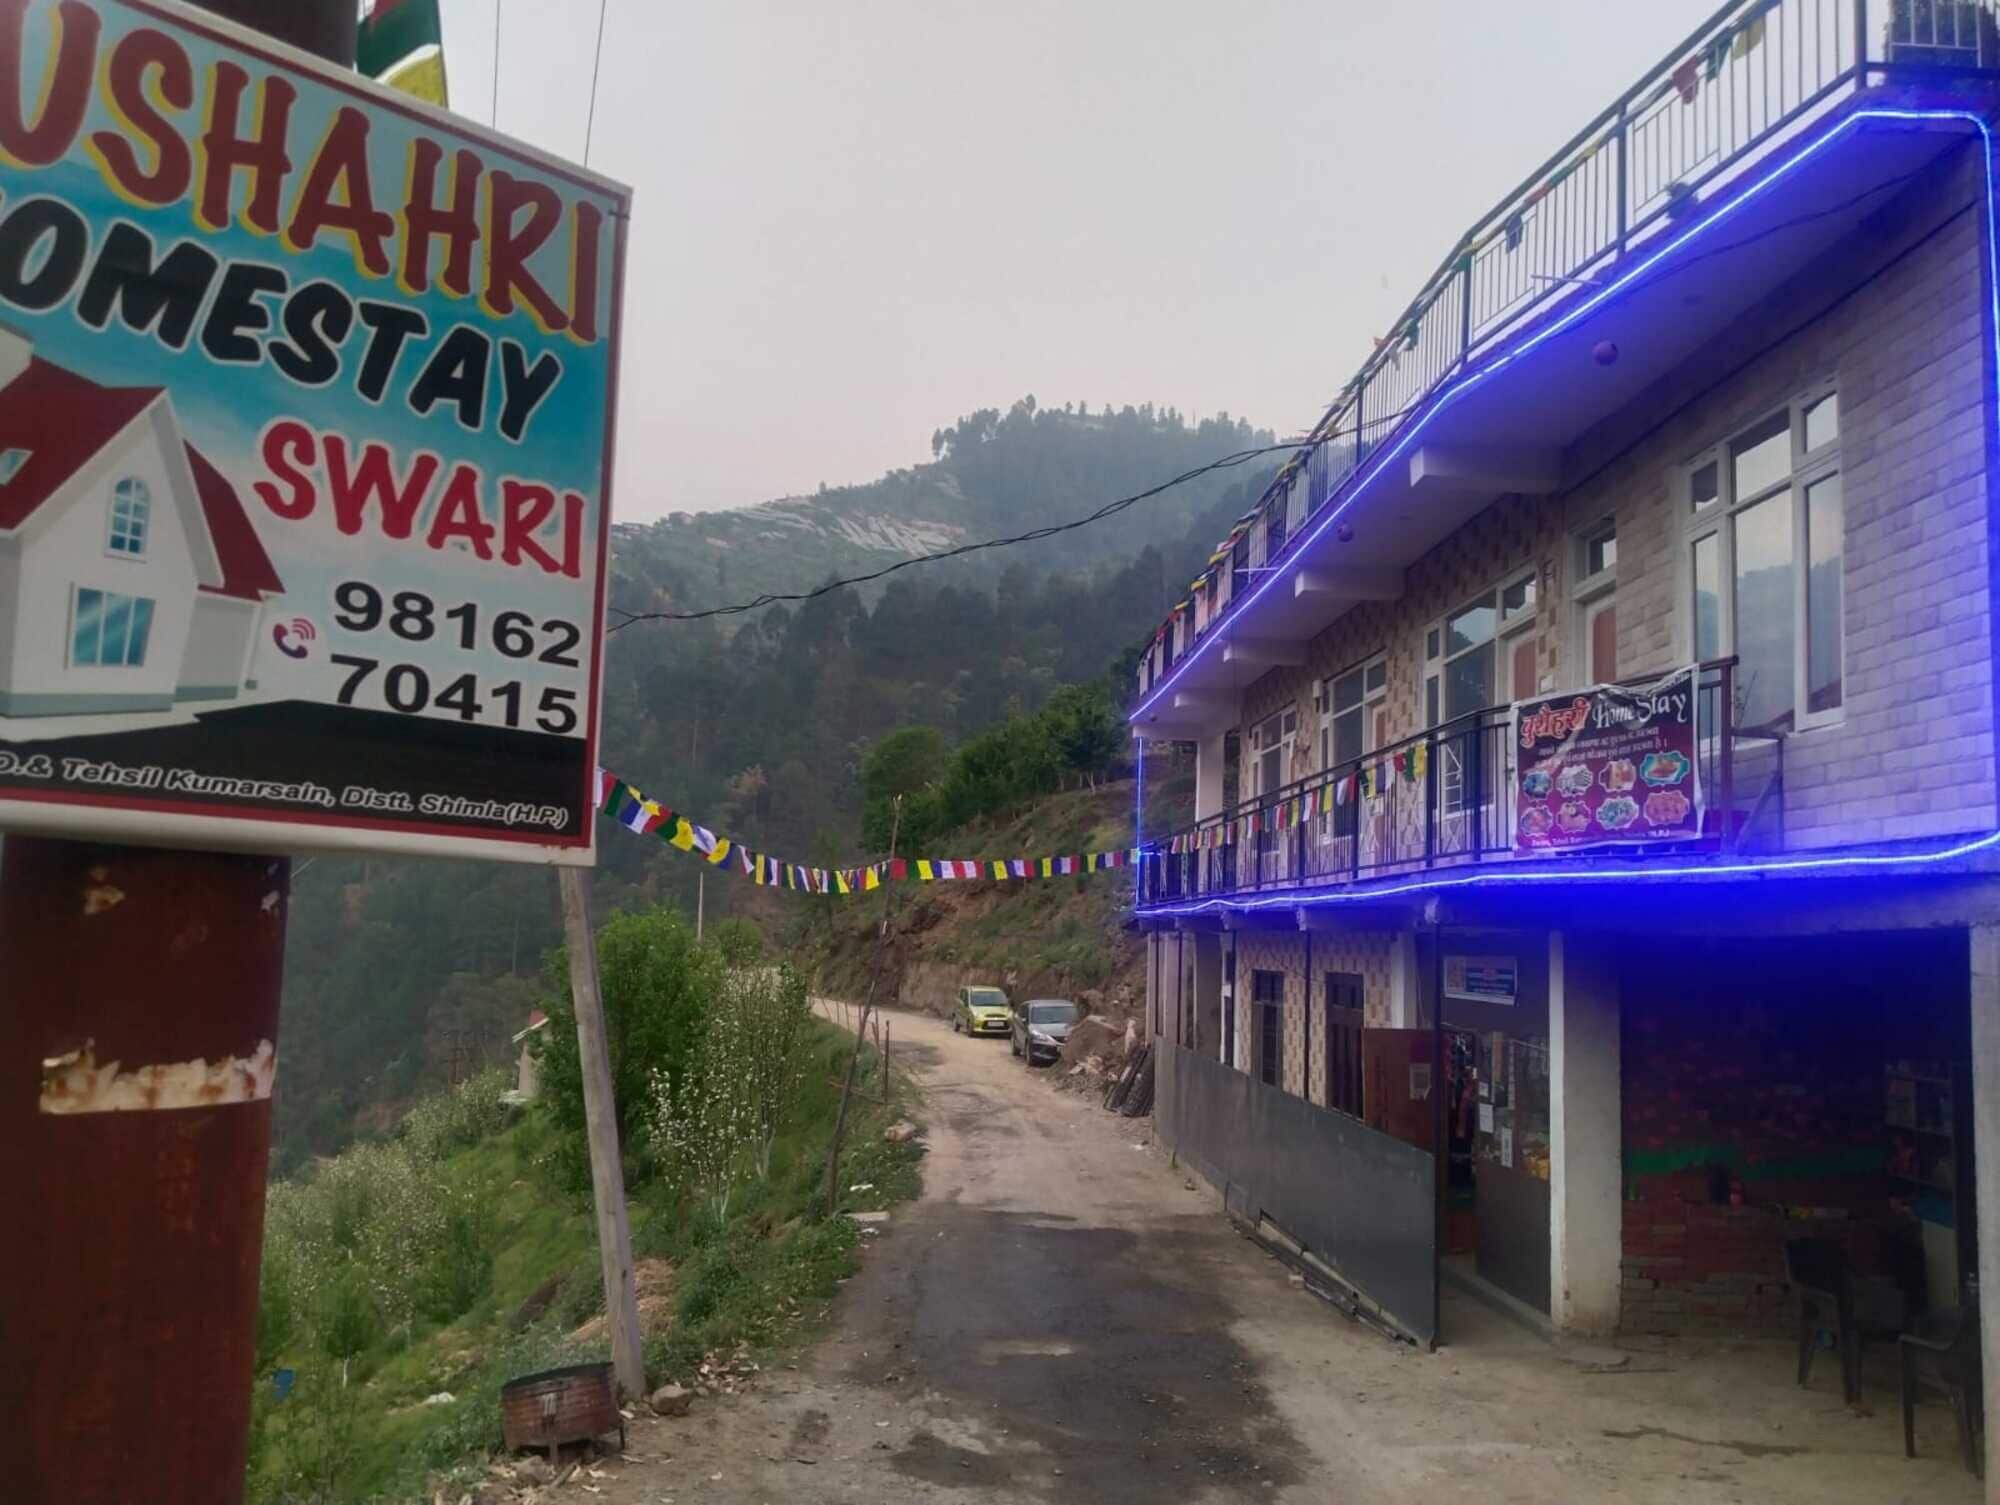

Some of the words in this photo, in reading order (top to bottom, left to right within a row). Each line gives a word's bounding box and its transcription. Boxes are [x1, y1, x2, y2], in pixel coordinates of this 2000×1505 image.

[0, 0, 603, 345] USHAHRI
[253, 417, 586, 579] SWARI
[333, 580, 582, 669] 98162
[329, 653, 579, 735] 70415
[1635, 693, 1688, 723] Stay
[61, 758, 163, 789] Tehsil
[164, 768, 337, 807] Kumarsain,
[340, 785, 415, 813] Distt.
[417, 793, 569, 830] Shimla(H.P.)
